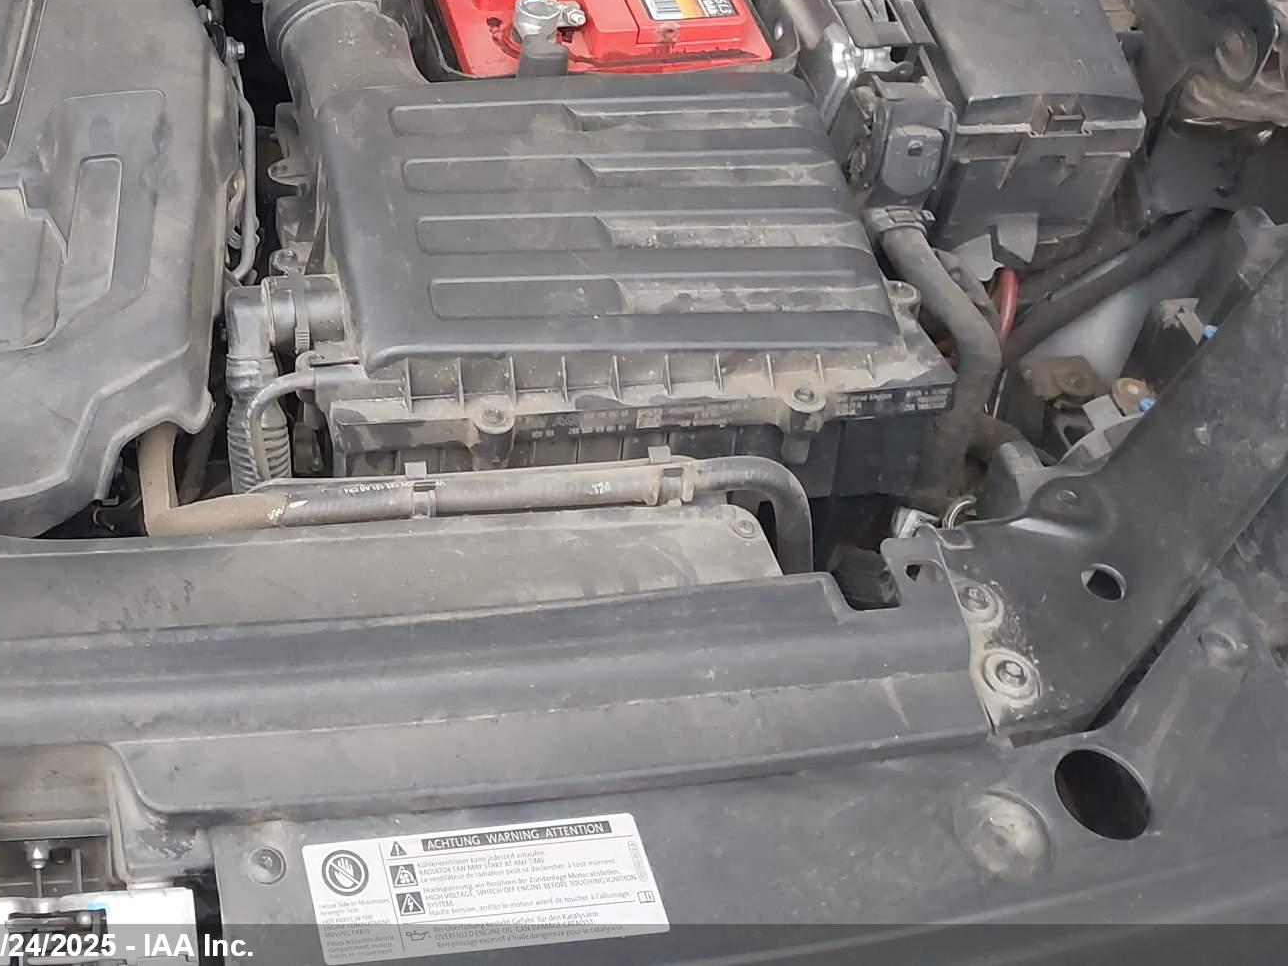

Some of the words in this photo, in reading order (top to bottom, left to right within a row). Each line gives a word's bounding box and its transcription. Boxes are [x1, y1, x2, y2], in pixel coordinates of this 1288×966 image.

[427, 835, 481, 850] ACHTUNG
[485, 829, 540, 844] WARNING
[545, 822, 604, 837] ATTENTION
